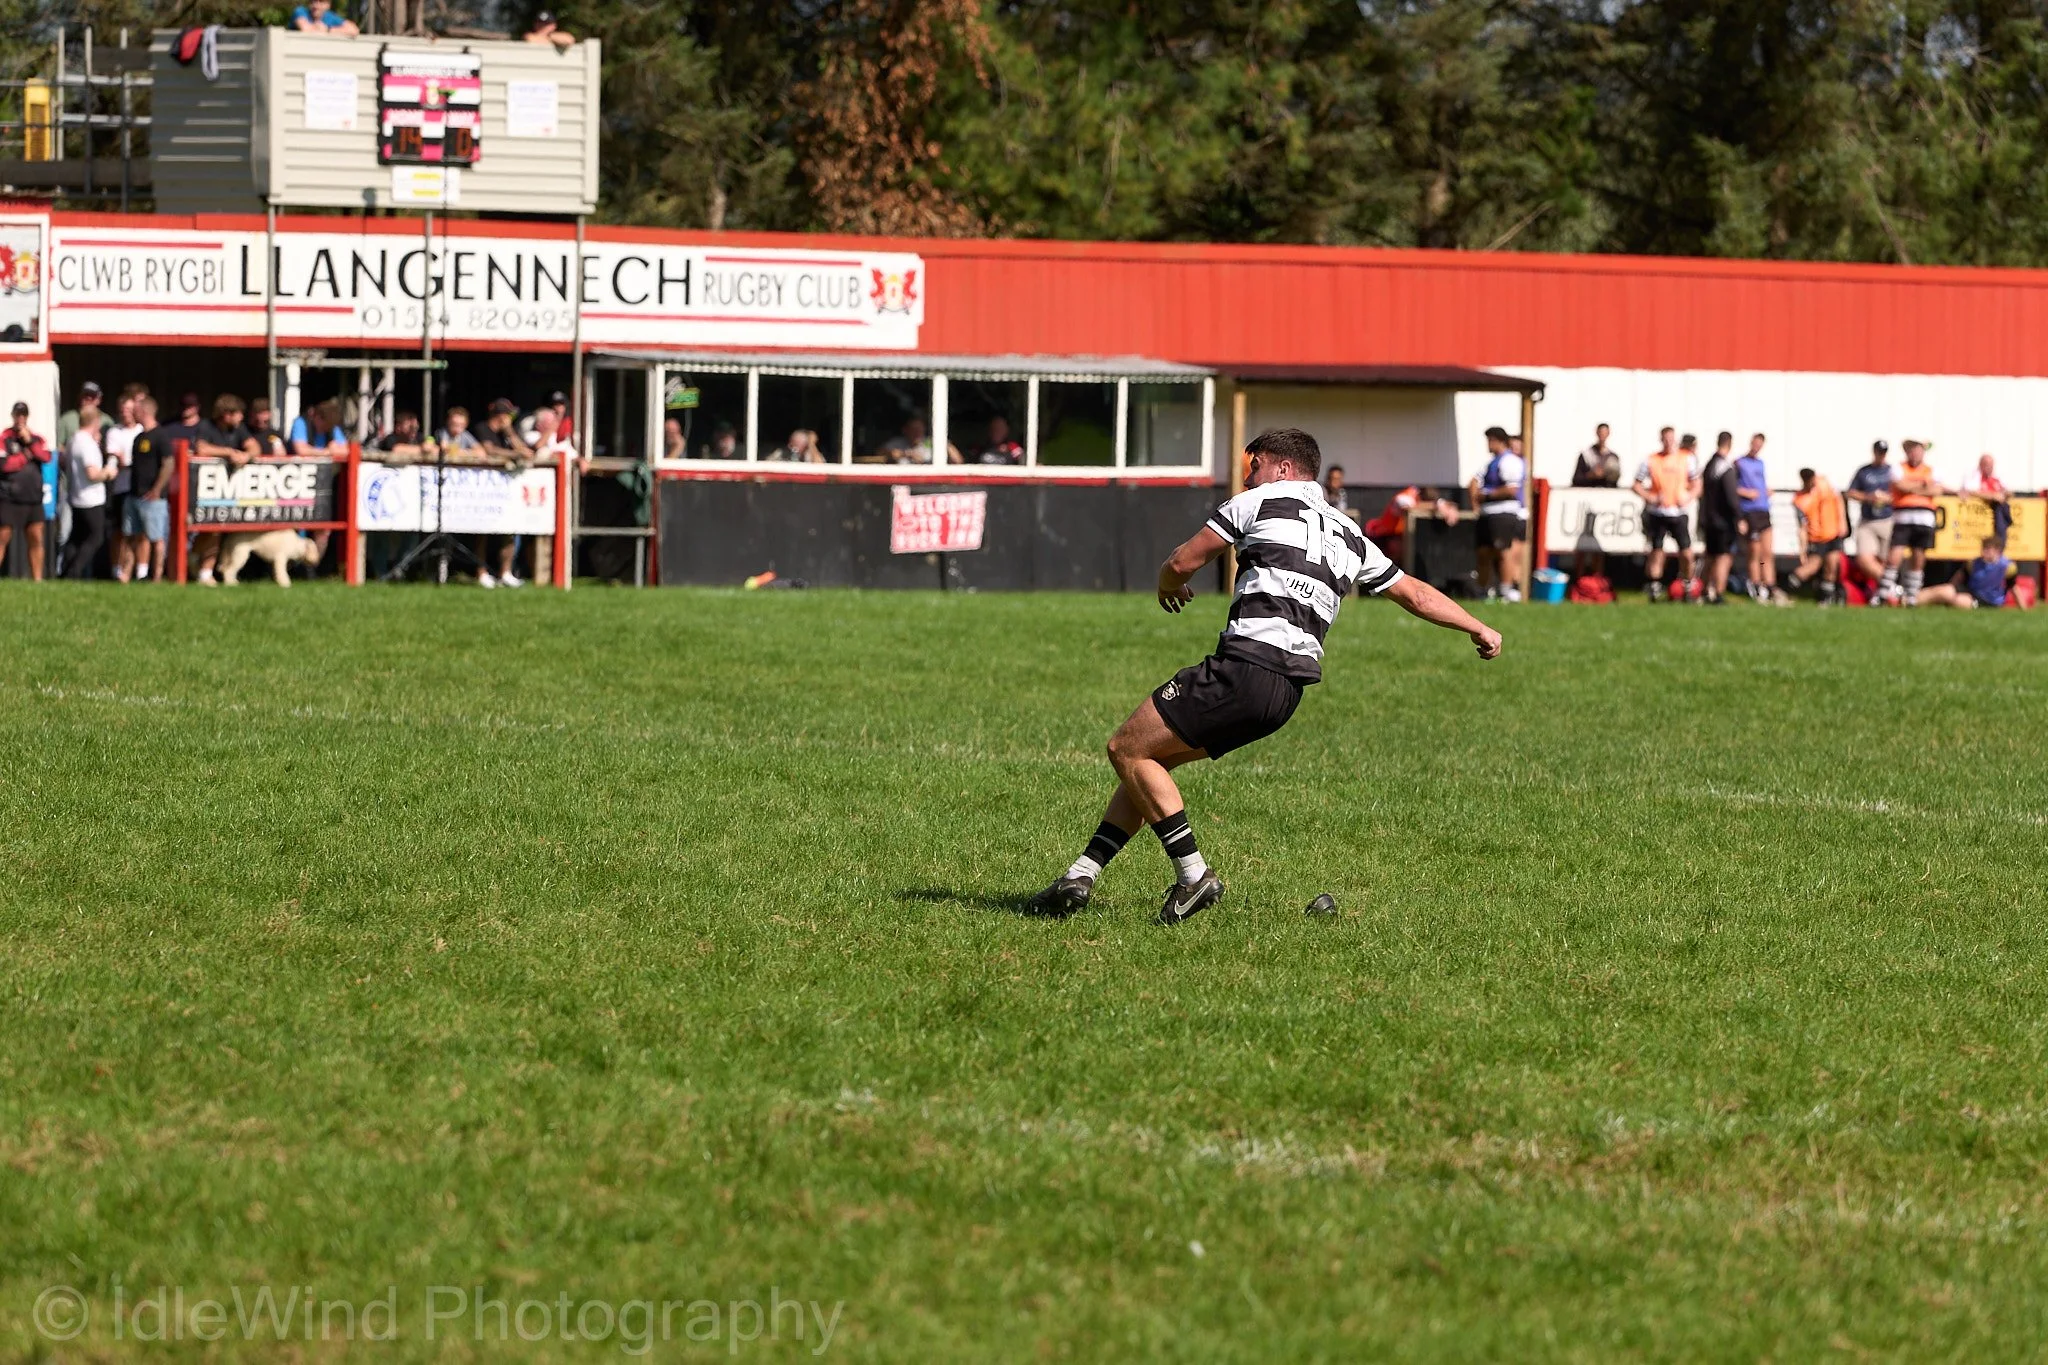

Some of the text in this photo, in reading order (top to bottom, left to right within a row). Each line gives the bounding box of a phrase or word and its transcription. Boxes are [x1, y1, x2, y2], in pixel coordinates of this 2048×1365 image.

[58, 244, 862, 309] CLWB RYGBI LLANGENNECH RUGBY CLUB
[468, 307, 575, 332] 820495
[196, 463, 318, 500] EMERGE
[1298, 508, 1349, 580] 15
